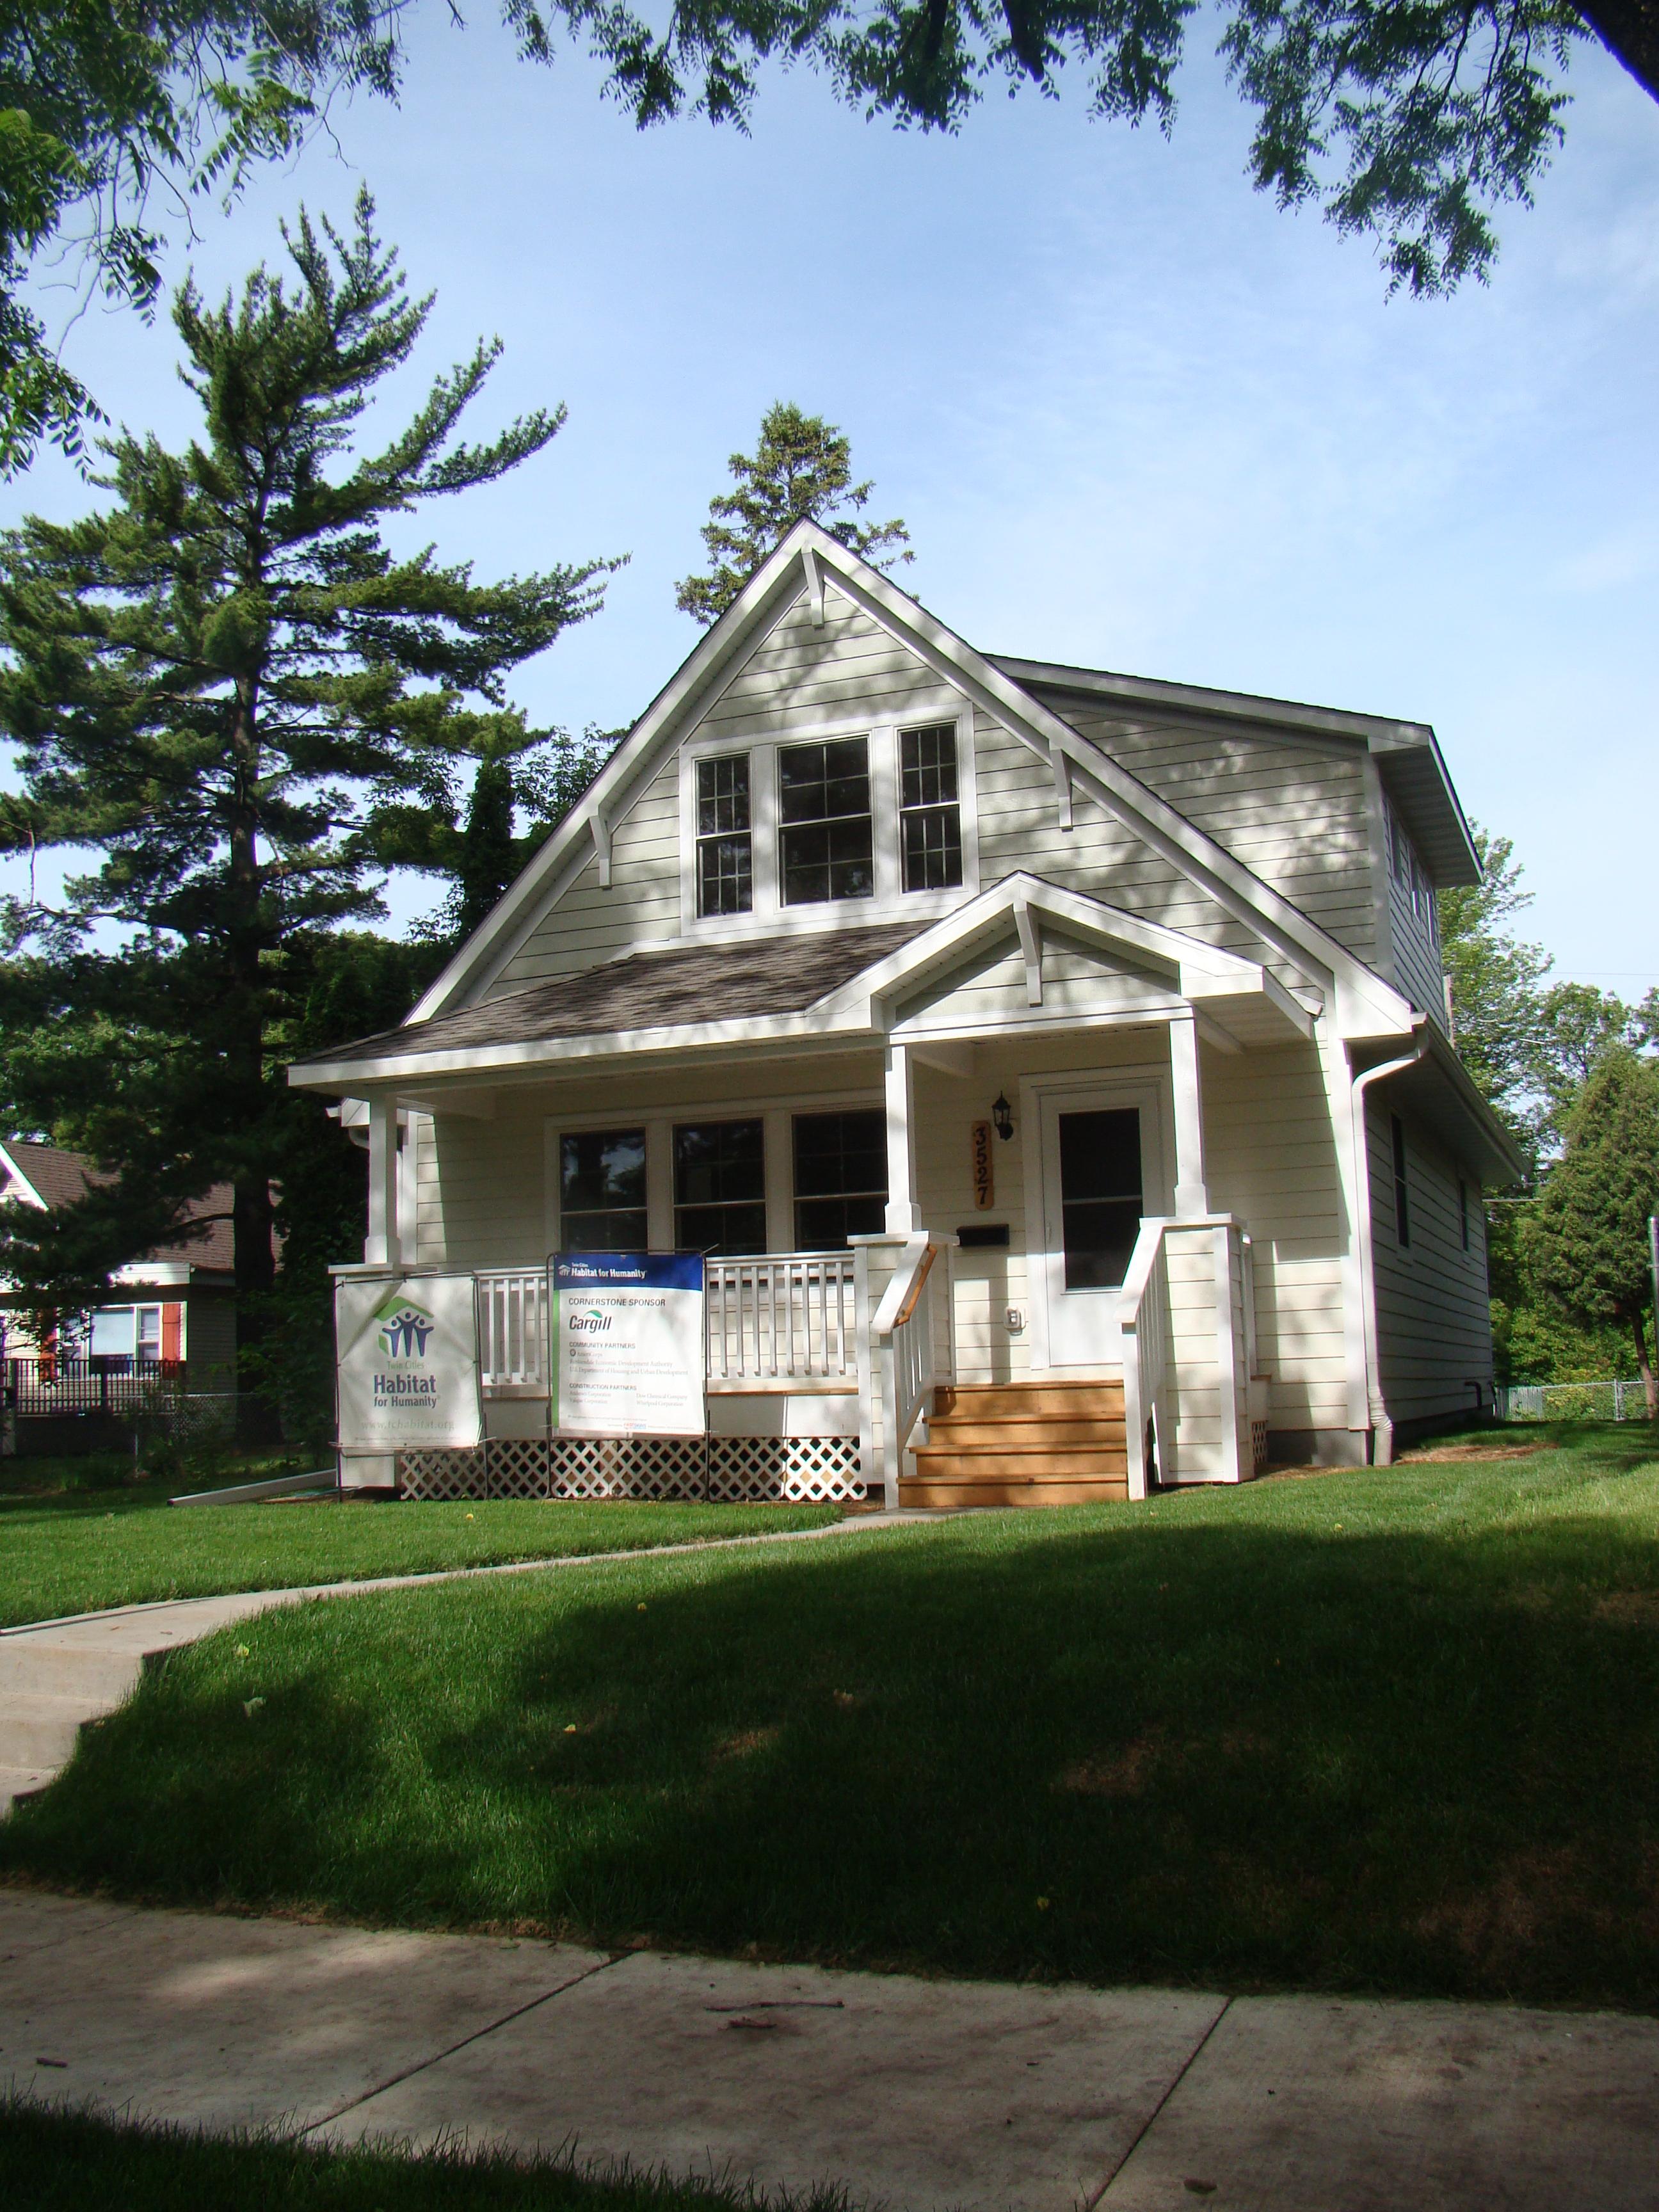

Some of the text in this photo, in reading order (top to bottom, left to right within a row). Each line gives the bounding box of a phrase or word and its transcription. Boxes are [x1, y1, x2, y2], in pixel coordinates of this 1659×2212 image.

[976, 1126, 988, 1205] 3527
[571, 1268, 646, 1279] Habitat for Humanity
[568, 1297, 627, 1306] CORNERSTONE
[569, 1315, 612, 1334] Cargill
[387, 1360, 424, 1370] Twin Cities
[374, 1374, 437, 1393] Habitat
[374, 1395, 437, 1408] for Humanity
